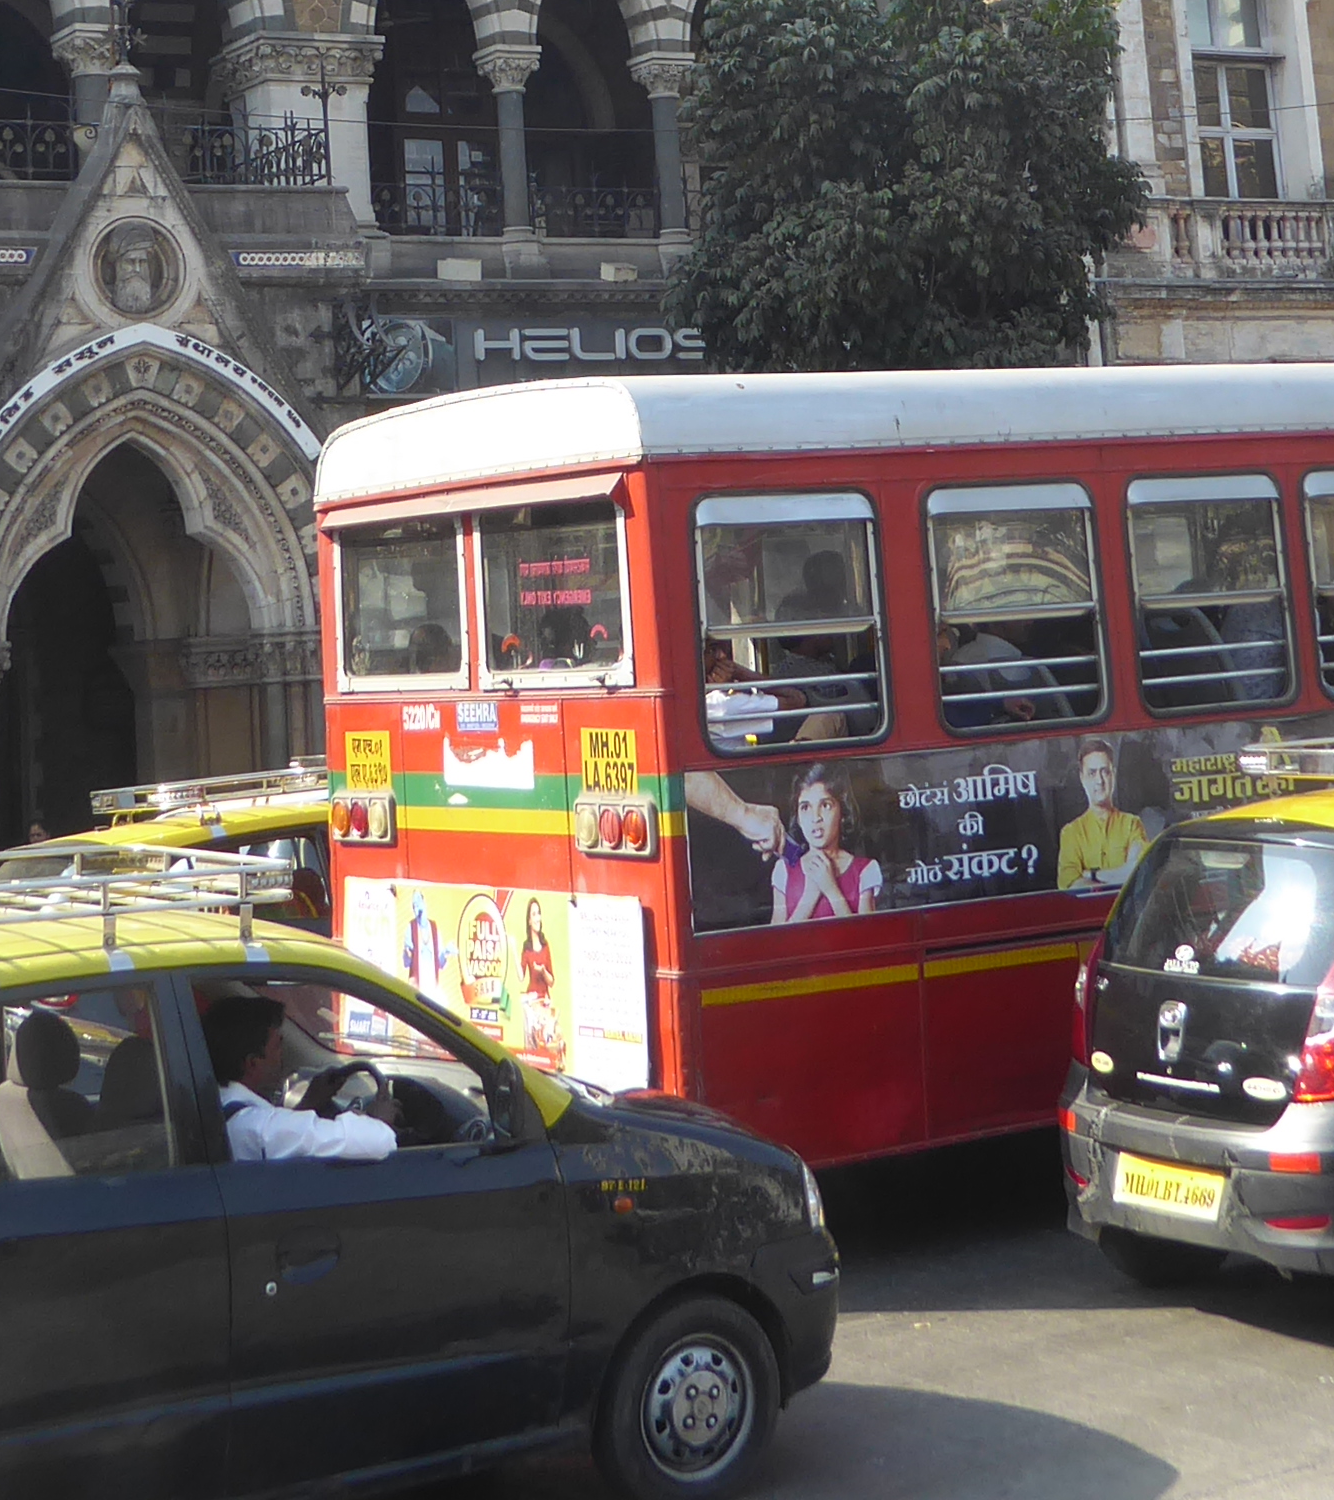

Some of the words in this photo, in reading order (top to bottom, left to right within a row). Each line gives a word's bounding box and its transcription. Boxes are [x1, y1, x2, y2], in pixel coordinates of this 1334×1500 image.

[473, 327, 705, 361] HELIOS
[457, 702, 498, 723] SEEHRA
[589, 731, 629, 759] MH.01
[584, 760, 635, 794] LA.6397
[898, 780, 949, 809] छोटंसं
[953, 764, 1037, 803] आमिष
[957, 811, 984, 836] की
[906, 858, 943, 884] मोठं
[468, 920, 500, 940] FULL
[467, 939, 501, 960] PAISA
